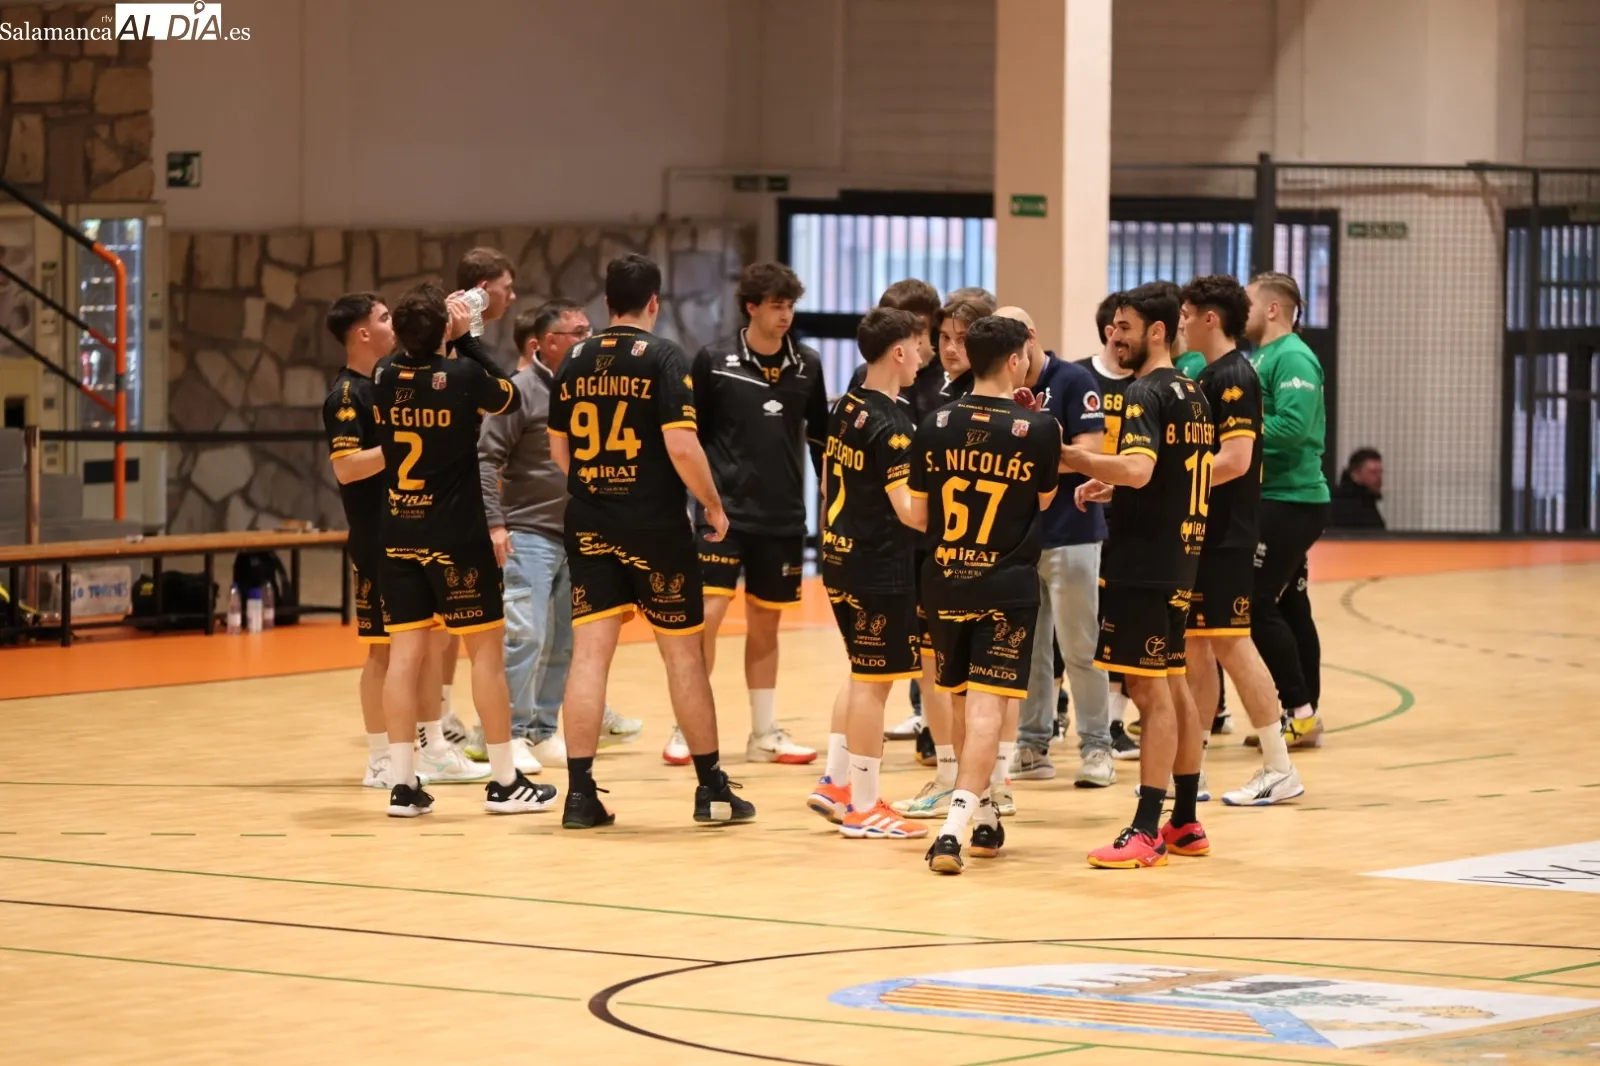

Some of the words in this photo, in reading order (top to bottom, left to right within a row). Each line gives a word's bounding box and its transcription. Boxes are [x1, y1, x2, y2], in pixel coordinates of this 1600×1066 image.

[575, 369, 652, 400] AGÚNDEZ
[389, 406, 452, 428] EGIDO
[1103, 393, 1124, 412] 68
[569, 400, 643, 462] 94
[1165, 422, 1180, 445] B.
[393, 430, 426, 491] 2
[925, 450, 941, 473] S.
[945, 448, 1035, 482] NICOLÁS
[1184, 449, 1215, 518] 10
[941, 475, 1009, 545] 67
